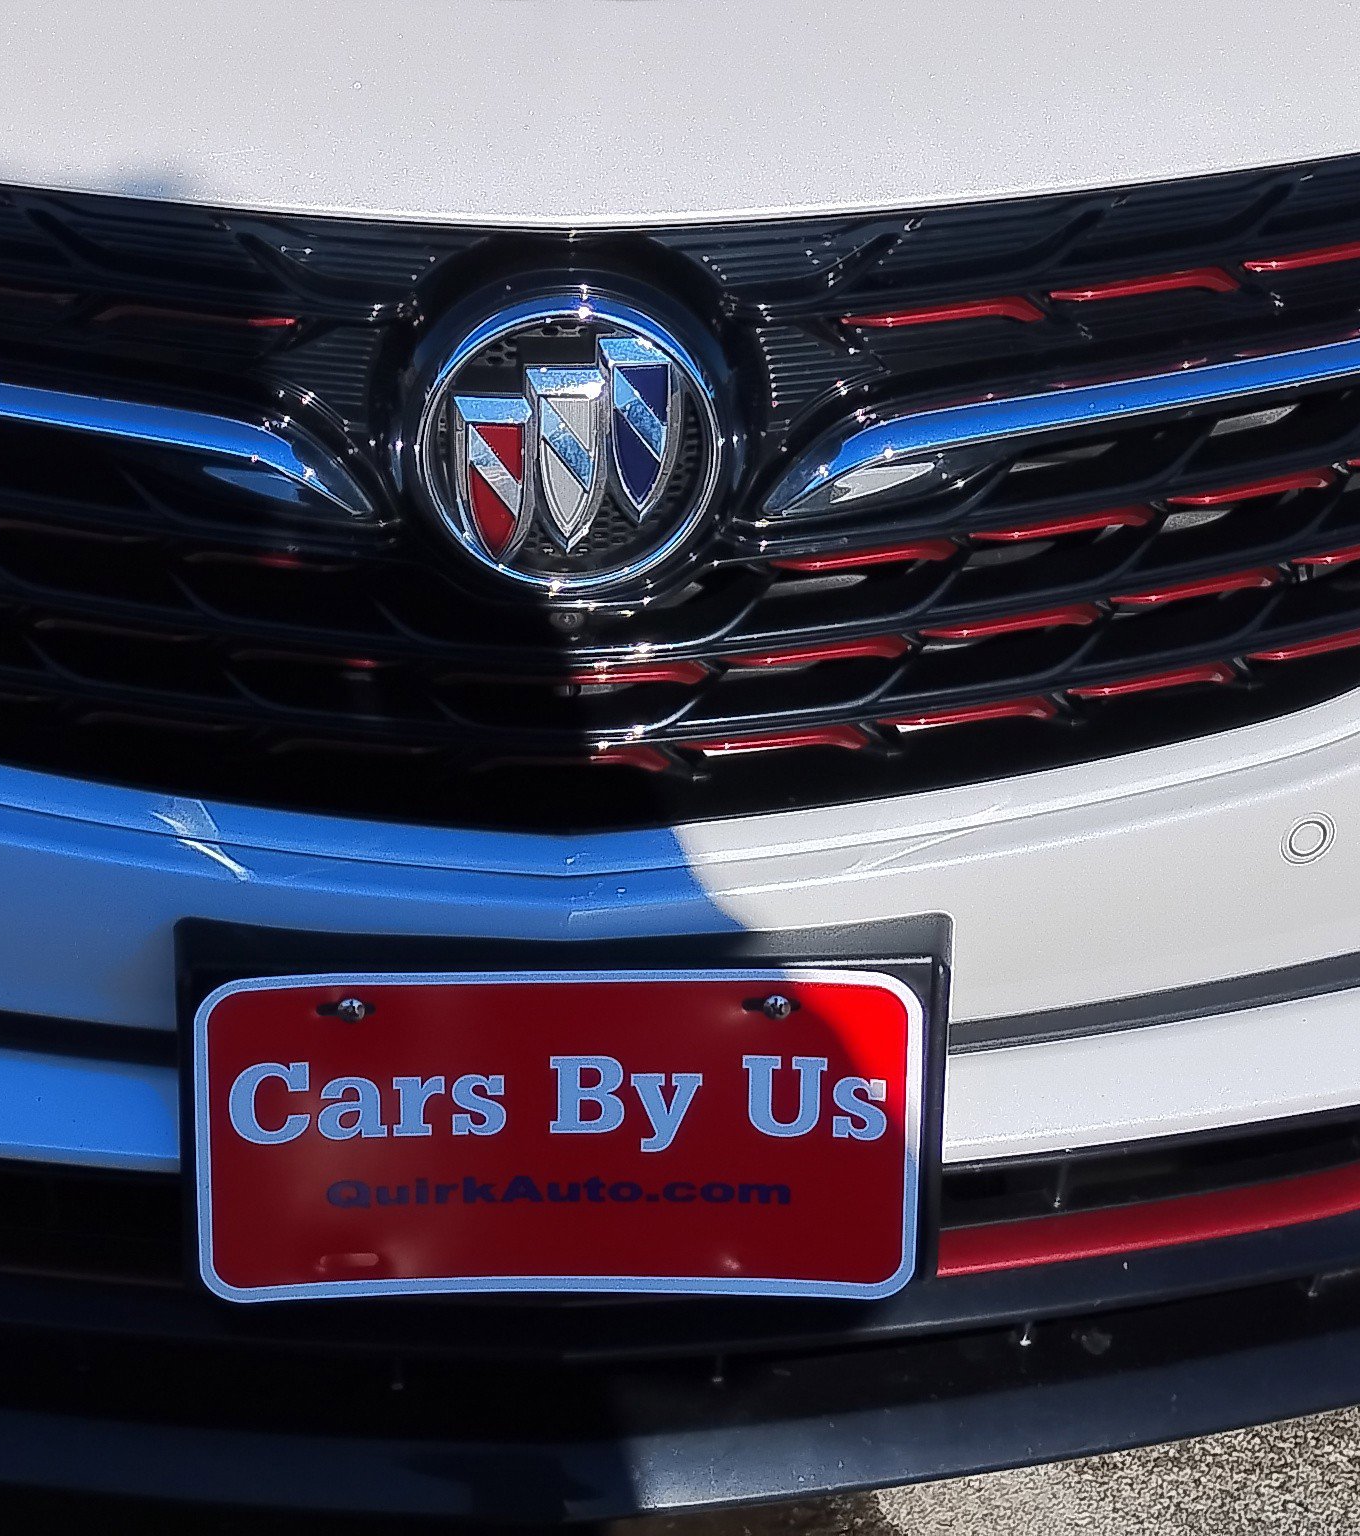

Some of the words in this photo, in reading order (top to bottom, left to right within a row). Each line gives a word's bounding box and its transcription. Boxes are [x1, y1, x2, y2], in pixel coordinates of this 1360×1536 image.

[228, 1061, 507, 1145] Cars
[549, 1055, 703, 1152] By
[741, 1055, 888, 1142] Us
[326, 1175, 792, 1207] QuirkAuto.com
